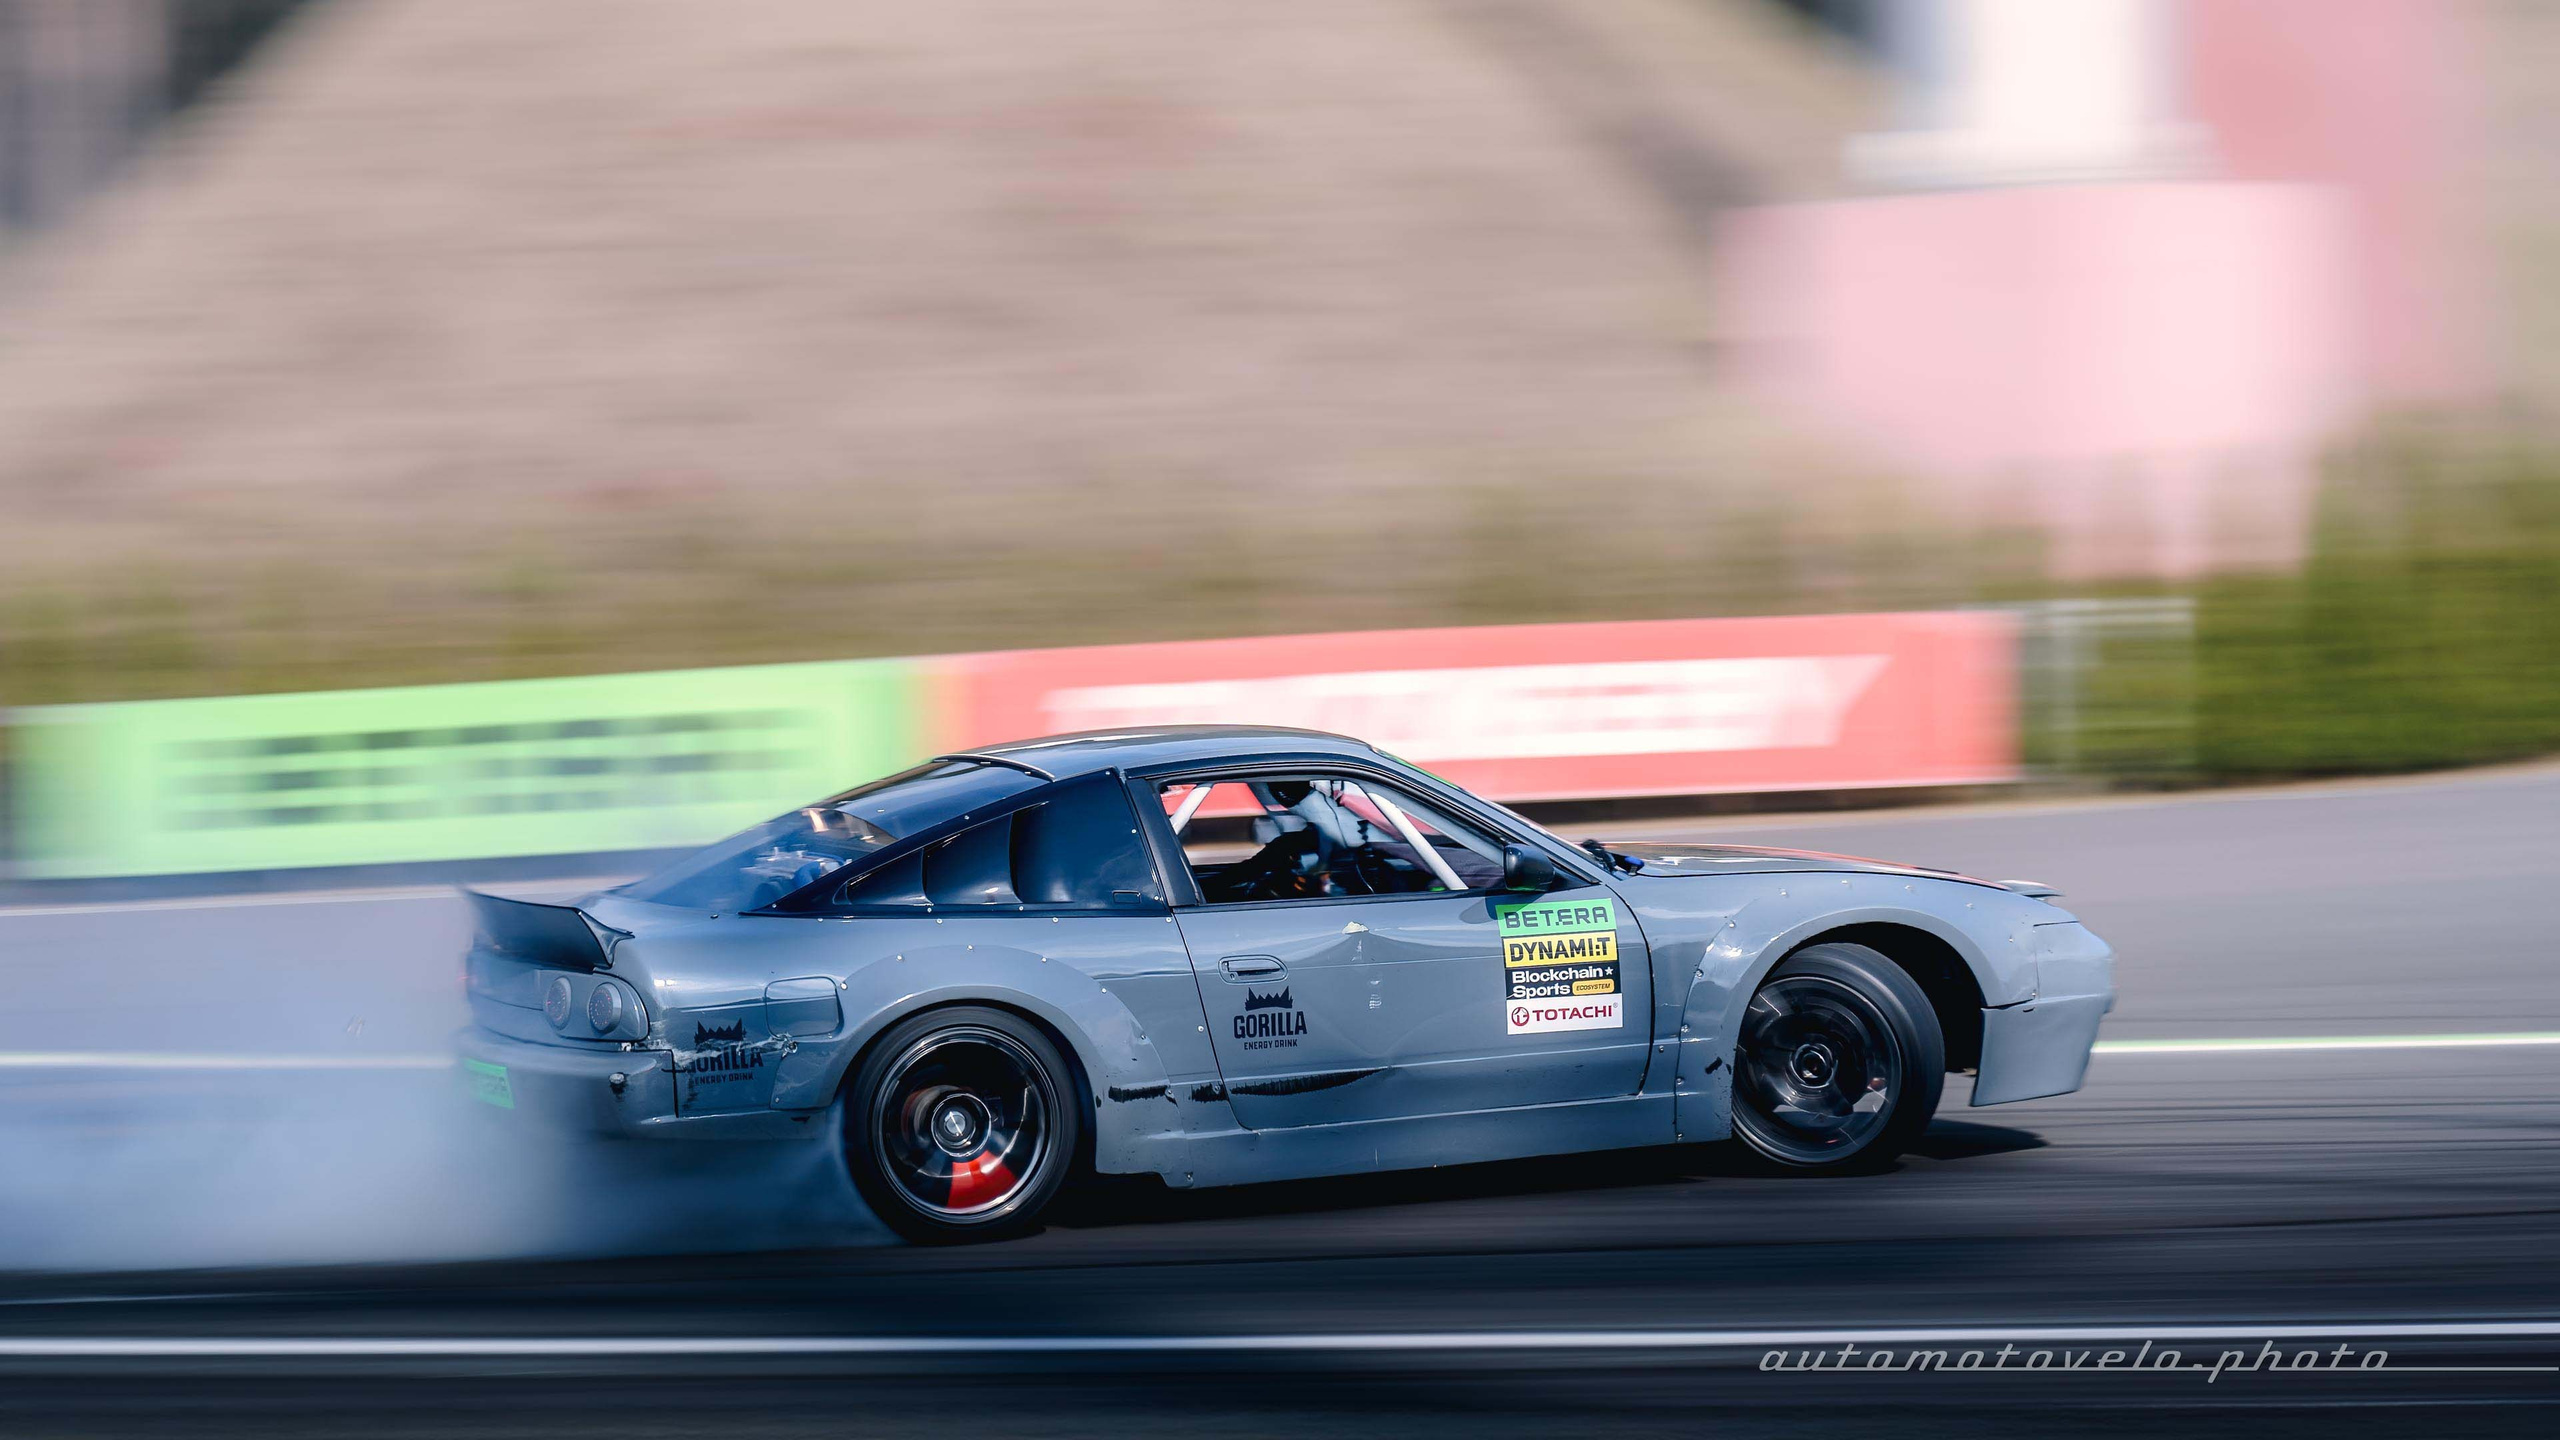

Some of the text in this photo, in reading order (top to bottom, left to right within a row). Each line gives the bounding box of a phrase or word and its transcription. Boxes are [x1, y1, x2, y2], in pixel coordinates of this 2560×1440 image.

[1512, 966, 1603, 983] Blockchain
[1512, 983, 1611, 999] Sports ECOSYSTEM
[1233, 1011, 1307, 1039] GORILLA
[1244, 1039, 1298, 1050] ENERGY DRINK
[728, 1072, 754, 1082] DRINK
